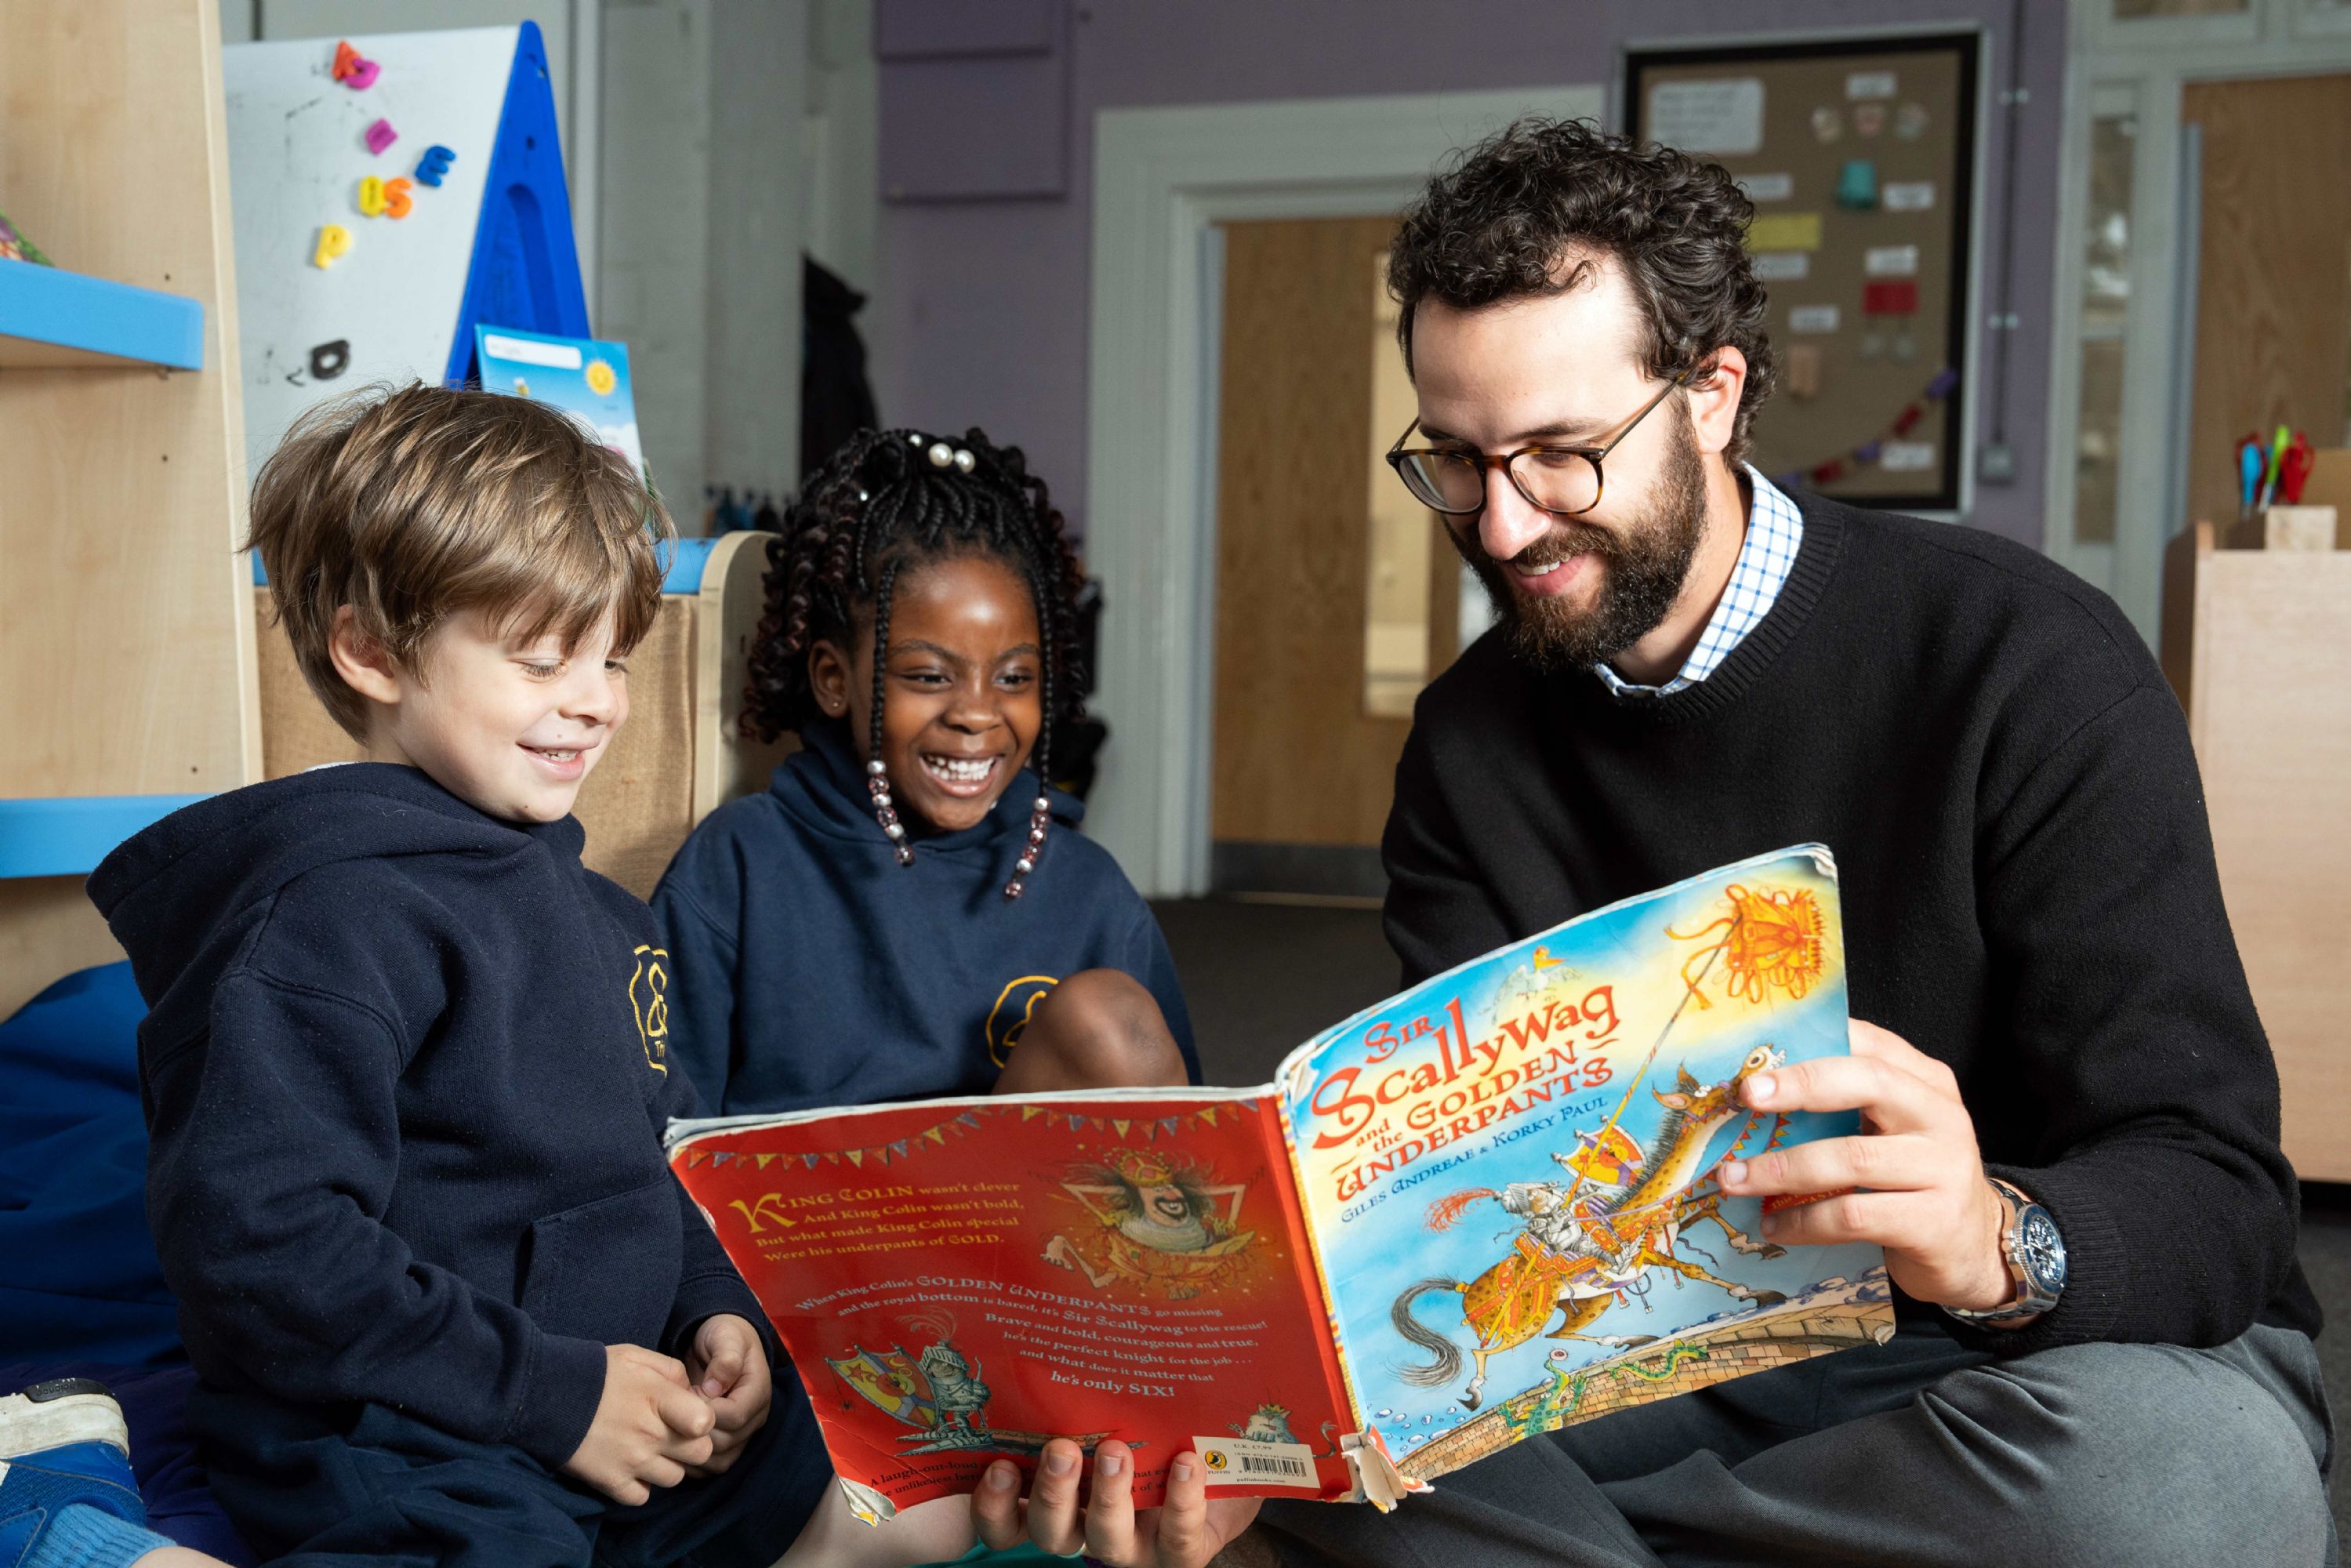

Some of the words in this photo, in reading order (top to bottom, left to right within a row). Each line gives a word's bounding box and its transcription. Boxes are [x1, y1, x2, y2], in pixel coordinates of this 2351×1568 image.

[1373, 1131, 1404, 1152] the
[1406, 1040, 1578, 1131] GOLDEN
[1336, 1058, 1613, 1203] UNDERPANTS
[1355, 1117, 1391, 1147] and
[1341, 1192, 1388, 1224] GILES
[1391, 1147, 1475, 1196] ANDREAE
[1479, 1146, 1488, 1155] &
[1492, 1115, 1555, 1148] KORKY
[1560, 1097, 1608, 1122] PAUL
[727, 1192, 834, 1233] KING
[838, 1185, 914, 1202] COLIN
[918, 1182, 969, 1195] wasn't
[973, 1182, 1020, 1192] clever
[804, 1211, 837, 1223] And
[840, 1208, 881, 1220] King
[883, 1204, 927, 1214] Colin
[931, 1200, 980, 1211] wasn't
[982, 1200, 1025, 1210] bold,
[756, 1236, 785, 1247] But
[789, 1232, 828, 1242] what
[831, 1226, 873, 1237] made
[876, 1223, 916, 1233] King
[918, 1219, 963, 1229] Colin
[966, 1217, 1019, 1229] special
[764, 1250, 806, 1261] Were
[808, 1247, 833, 1257] his
[836, 1240, 926, 1254] underpants
[928, 1235, 945, 1246] of
[795, 1293, 836, 1311] When
[836, 1285, 869, 1298] King
[869, 1279, 914, 1290] Colin's
[916, 1276, 1003, 1291] GOLDEN
[1009, 1284, 1151, 1316] UNDERPANTS
[1173, 1308, 1223, 1318] missing
[836, 1305, 859, 1317] and
[860, 1301, 880, 1310] the
[883, 1294, 916, 1306] royal
[918, 1293, 979, 1303] bottom
[997, 1298, 1038, 1312] bared,
[1042, 1307, 1059, 1316] it's
[1062, 1310, 1090, 1323] Sir
[1096, 1316, 1184, 1336] Scallywag
[1224, 1320, 1268, 1332] rescue!
[985, 1313, 1032, 1327] Brave
[1035, 1323, 1060, 1333] and
[1104, 1335, 1193, 1349] courageous
[1221, 1338, 1259, 1348] true,
[1003, 1331, 1027, 1341] he's
[1030, 1337, 1050, 1346] the
[1053, 1341, 1109, 1357] perfect
[1113, 1350, 1165, 1363] knight
[1212, 1356, 1232, 1366] job
[1019, 1349, 1044, 1359] and
[1047, 1354, 1087, 1368] what
[1088, 1363, 1117, 1374] does
[1134, 1370, 1185, 1380] matter
[1050, 1370, 1079, 1385] he's
[1083, 1379, 1124, 1394] only
[1129, 1383, 1175, 1397] SIX!
[870, 1479, 879, 1488] A
